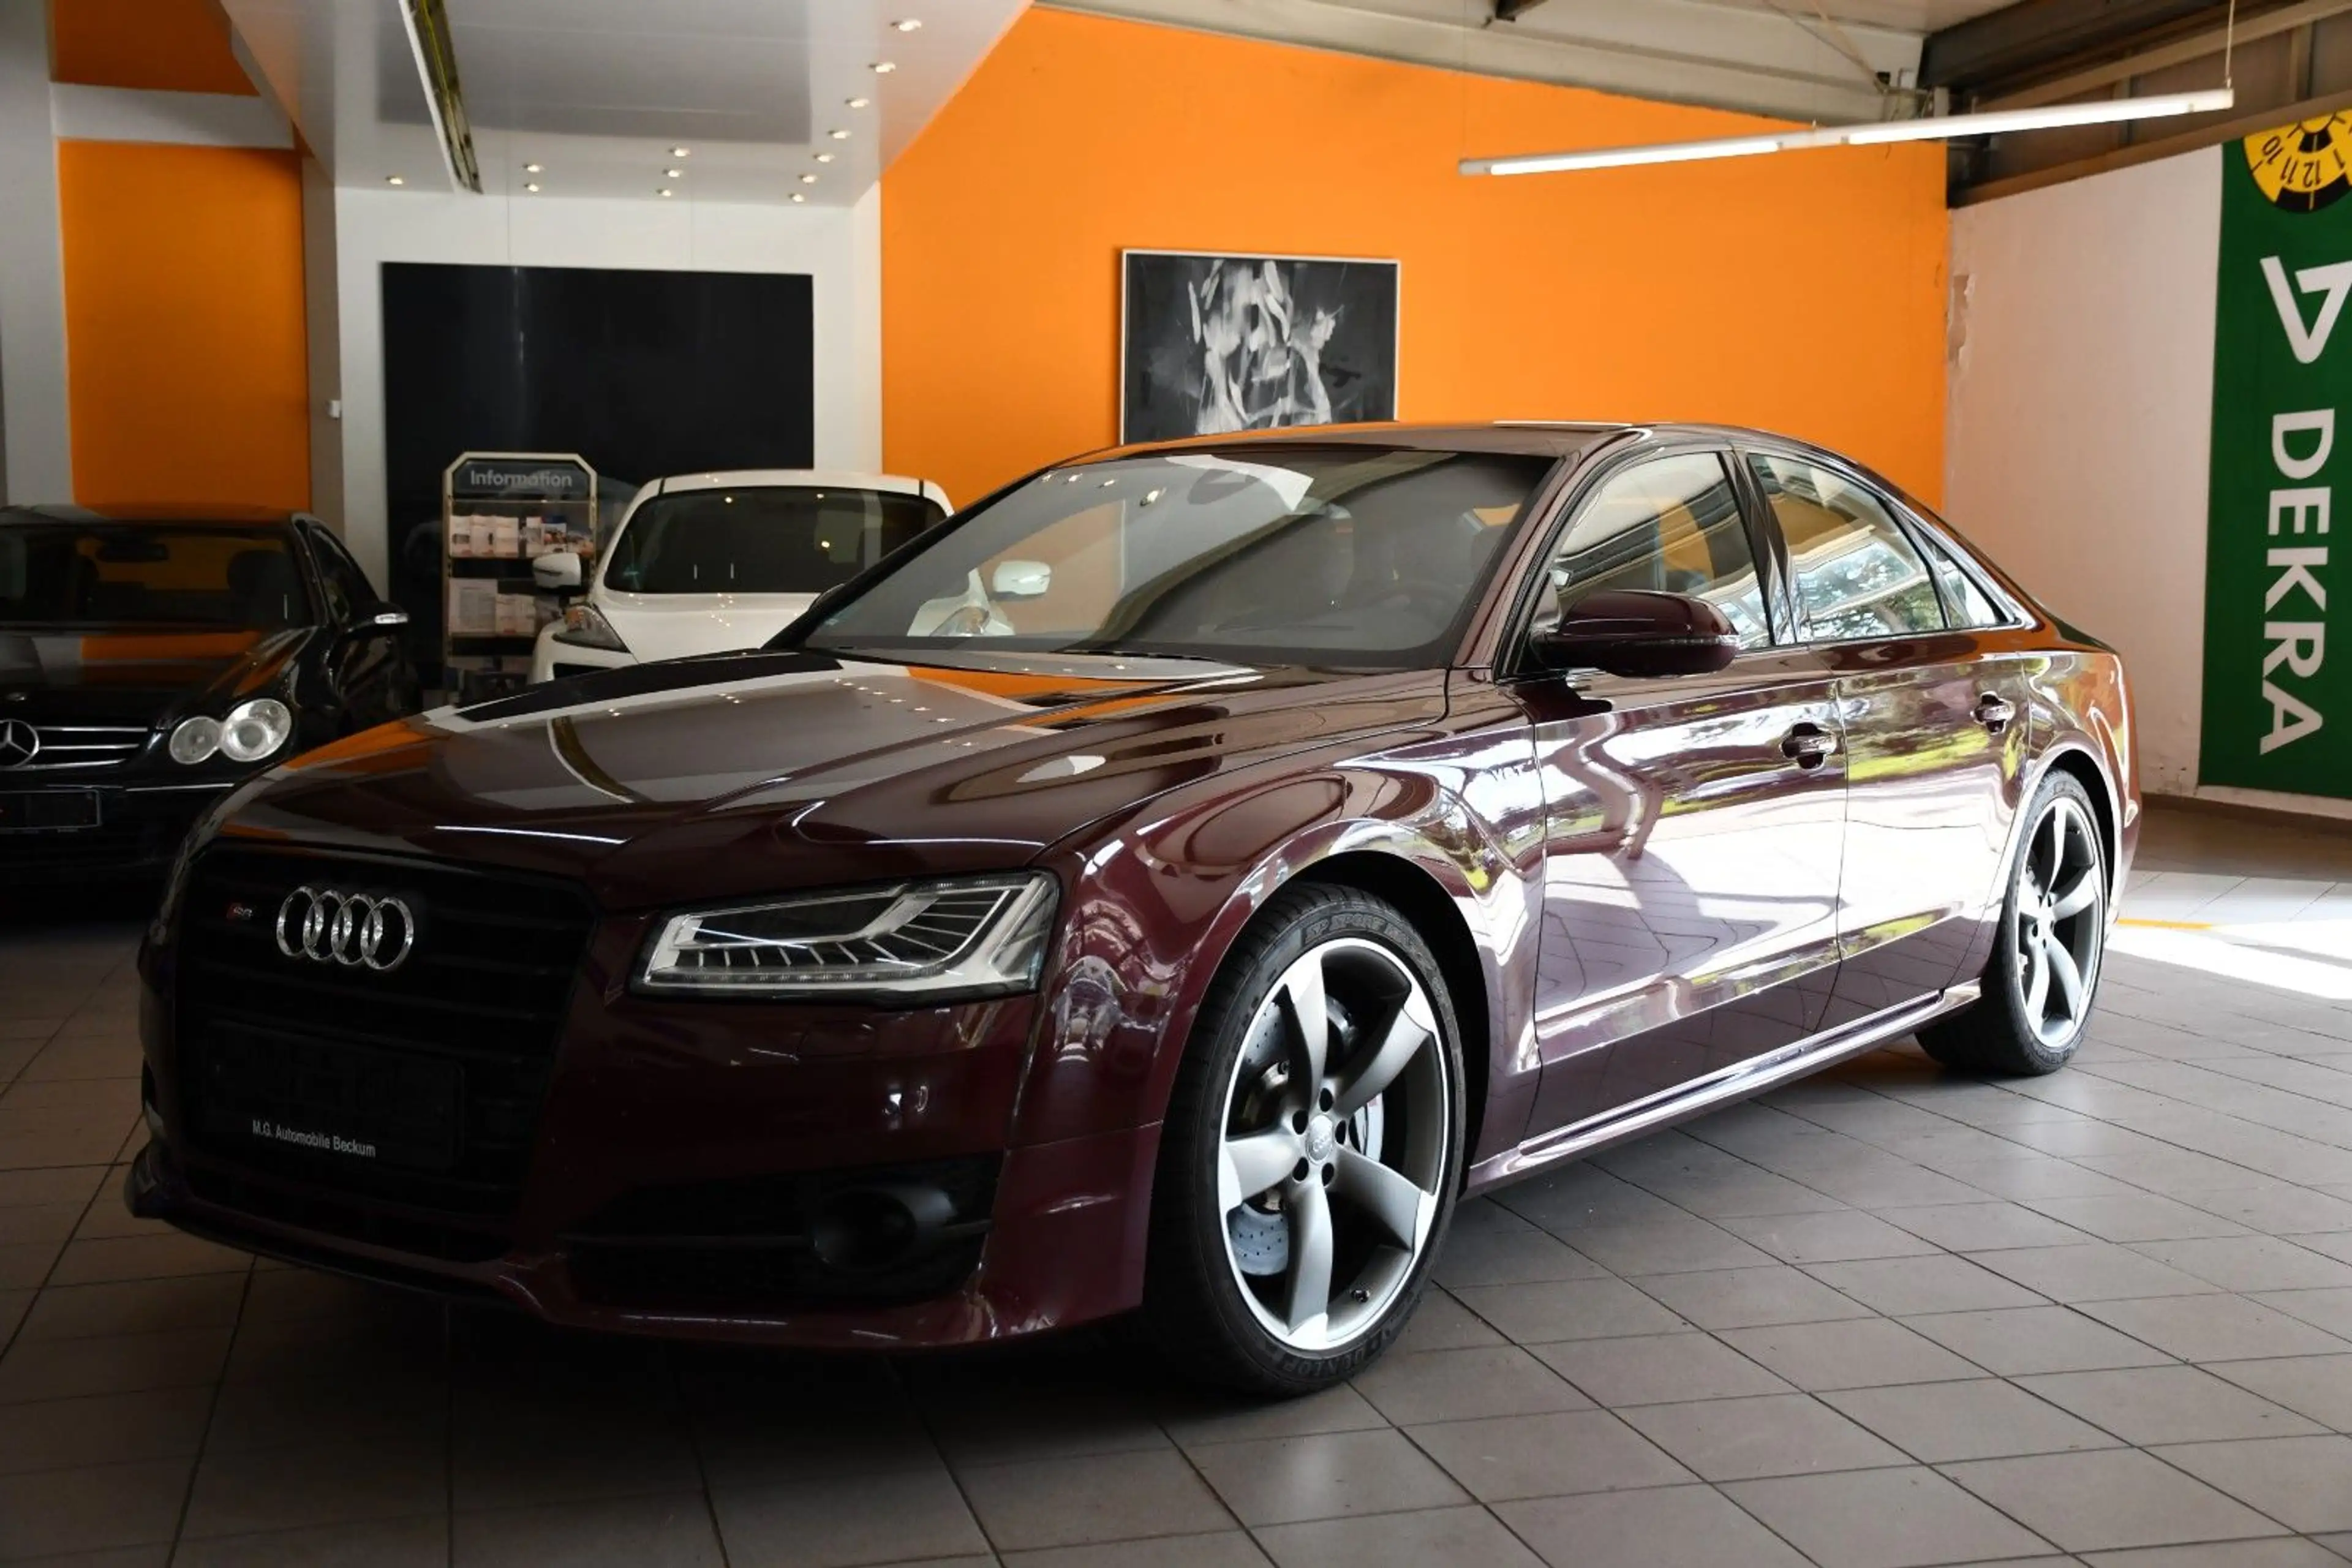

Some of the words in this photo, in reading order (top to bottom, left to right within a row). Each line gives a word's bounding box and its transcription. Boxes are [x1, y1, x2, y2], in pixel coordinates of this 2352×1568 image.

[2262, 135, 2284, 165] 10
[2280, 155, 2299, 184] 11
[2304, 159, 2321, 188] 12
[470, 469, 573, 488] Information
[2260, 408, 2335, 755] DEKRA
[252, 1119, 274, 1138] M.G.
[275, 1123, 331, 1150] Automobile
[332, 1135, 376, 1158] Beckum
